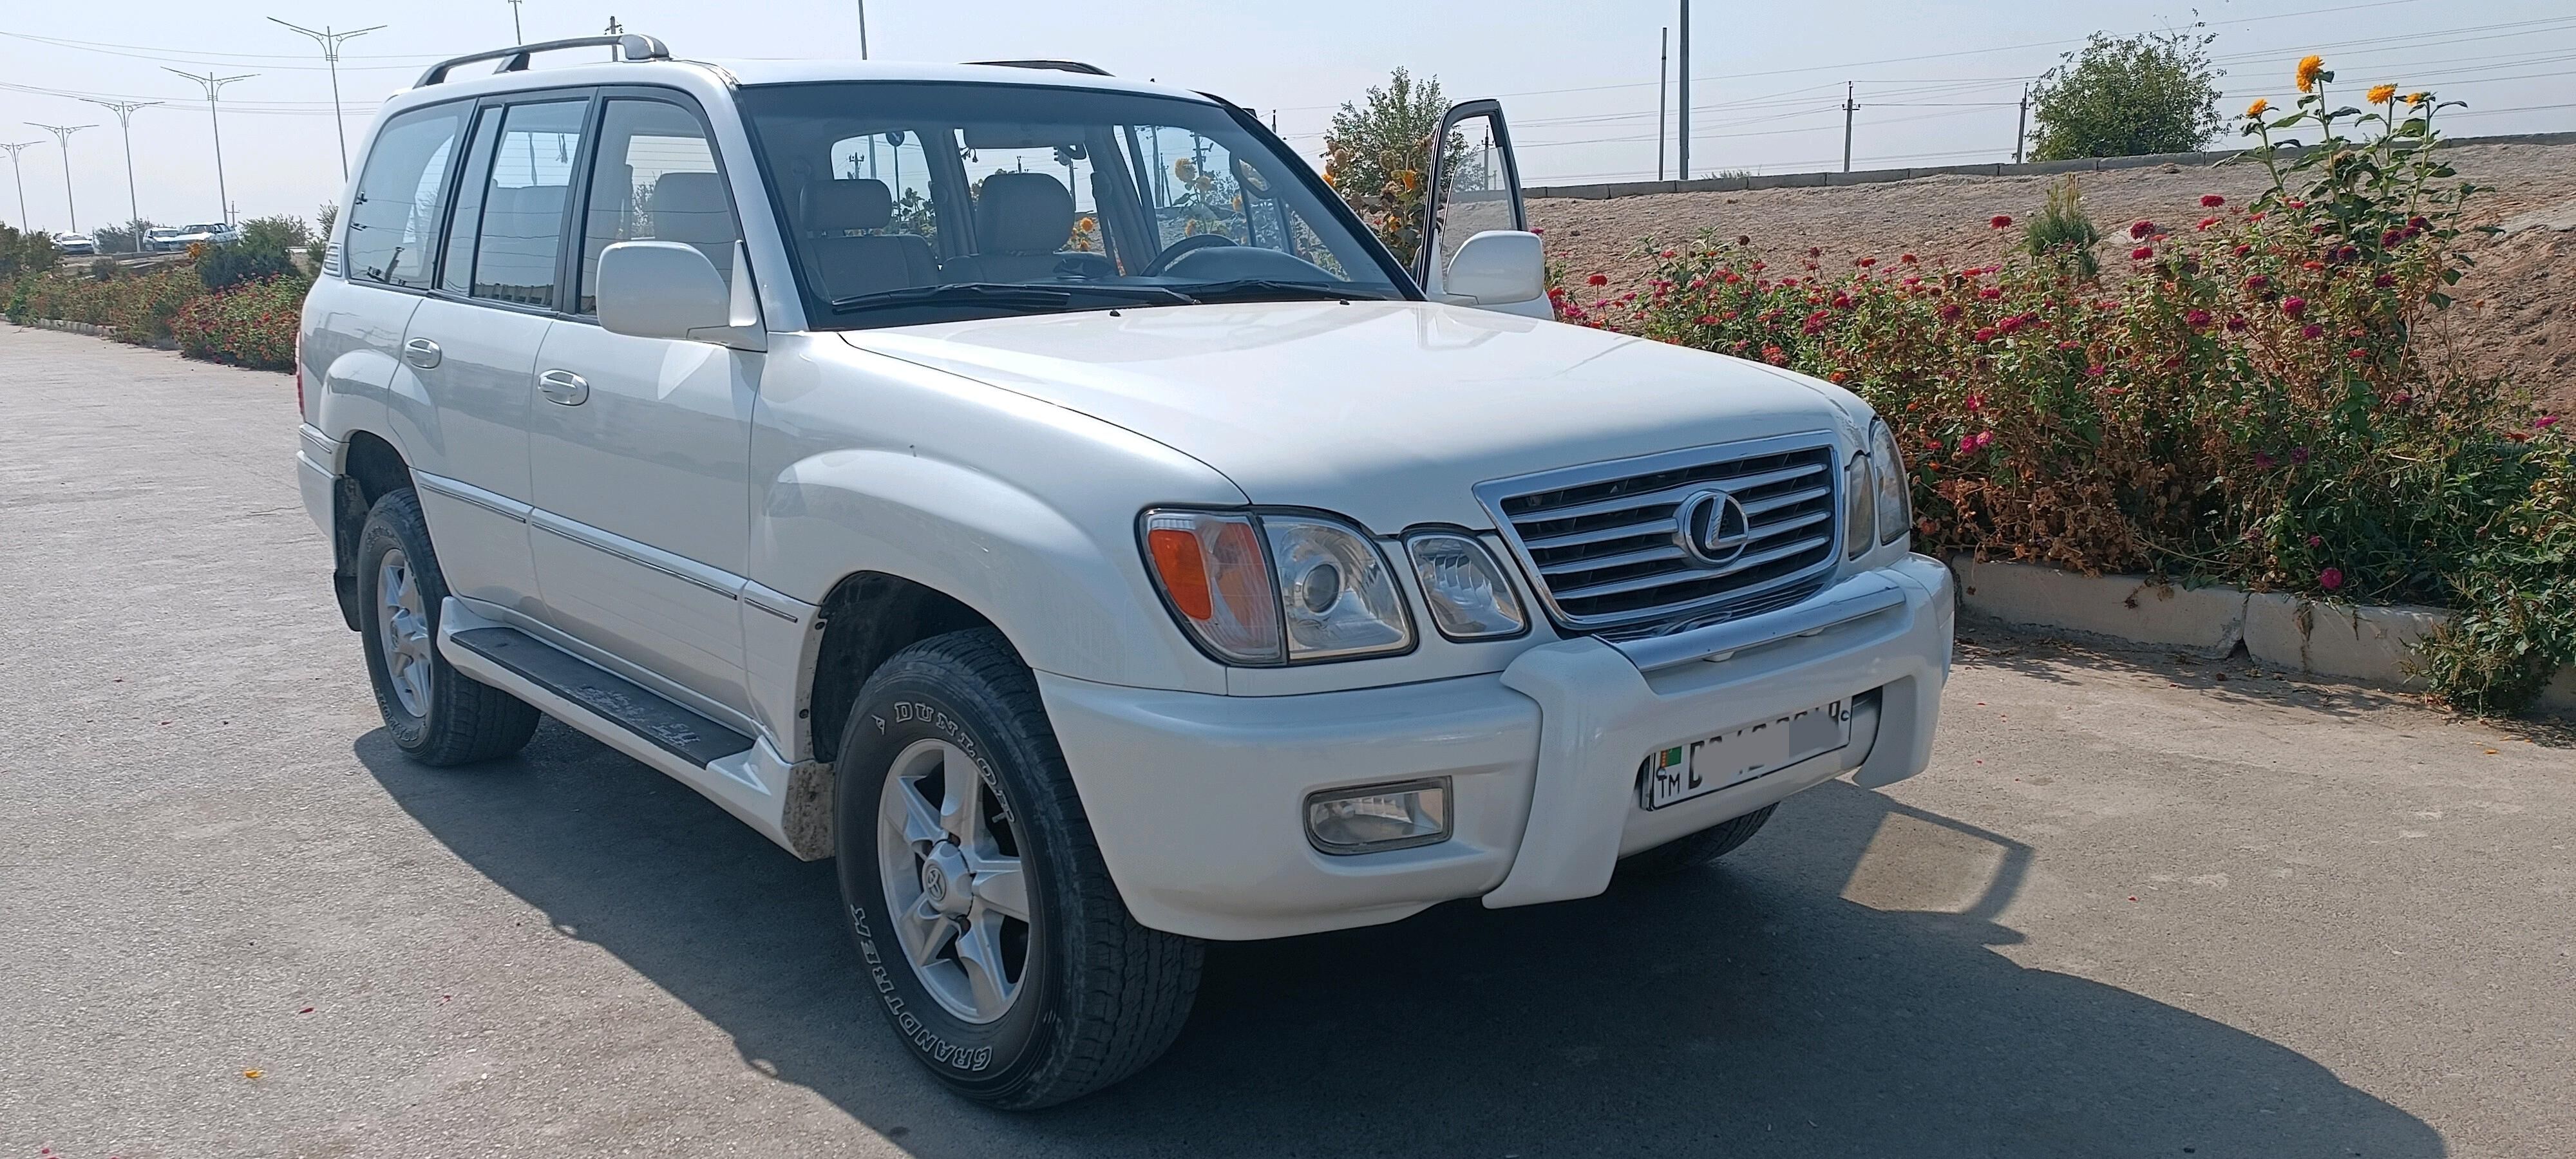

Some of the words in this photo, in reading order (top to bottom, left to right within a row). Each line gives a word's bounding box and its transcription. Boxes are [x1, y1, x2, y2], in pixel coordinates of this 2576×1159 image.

[894, 701, 1015, 823] DUNLOP
[1658, 773, 1680, 798] TM
[850, 903, 993, 1071] GRANDTREK
